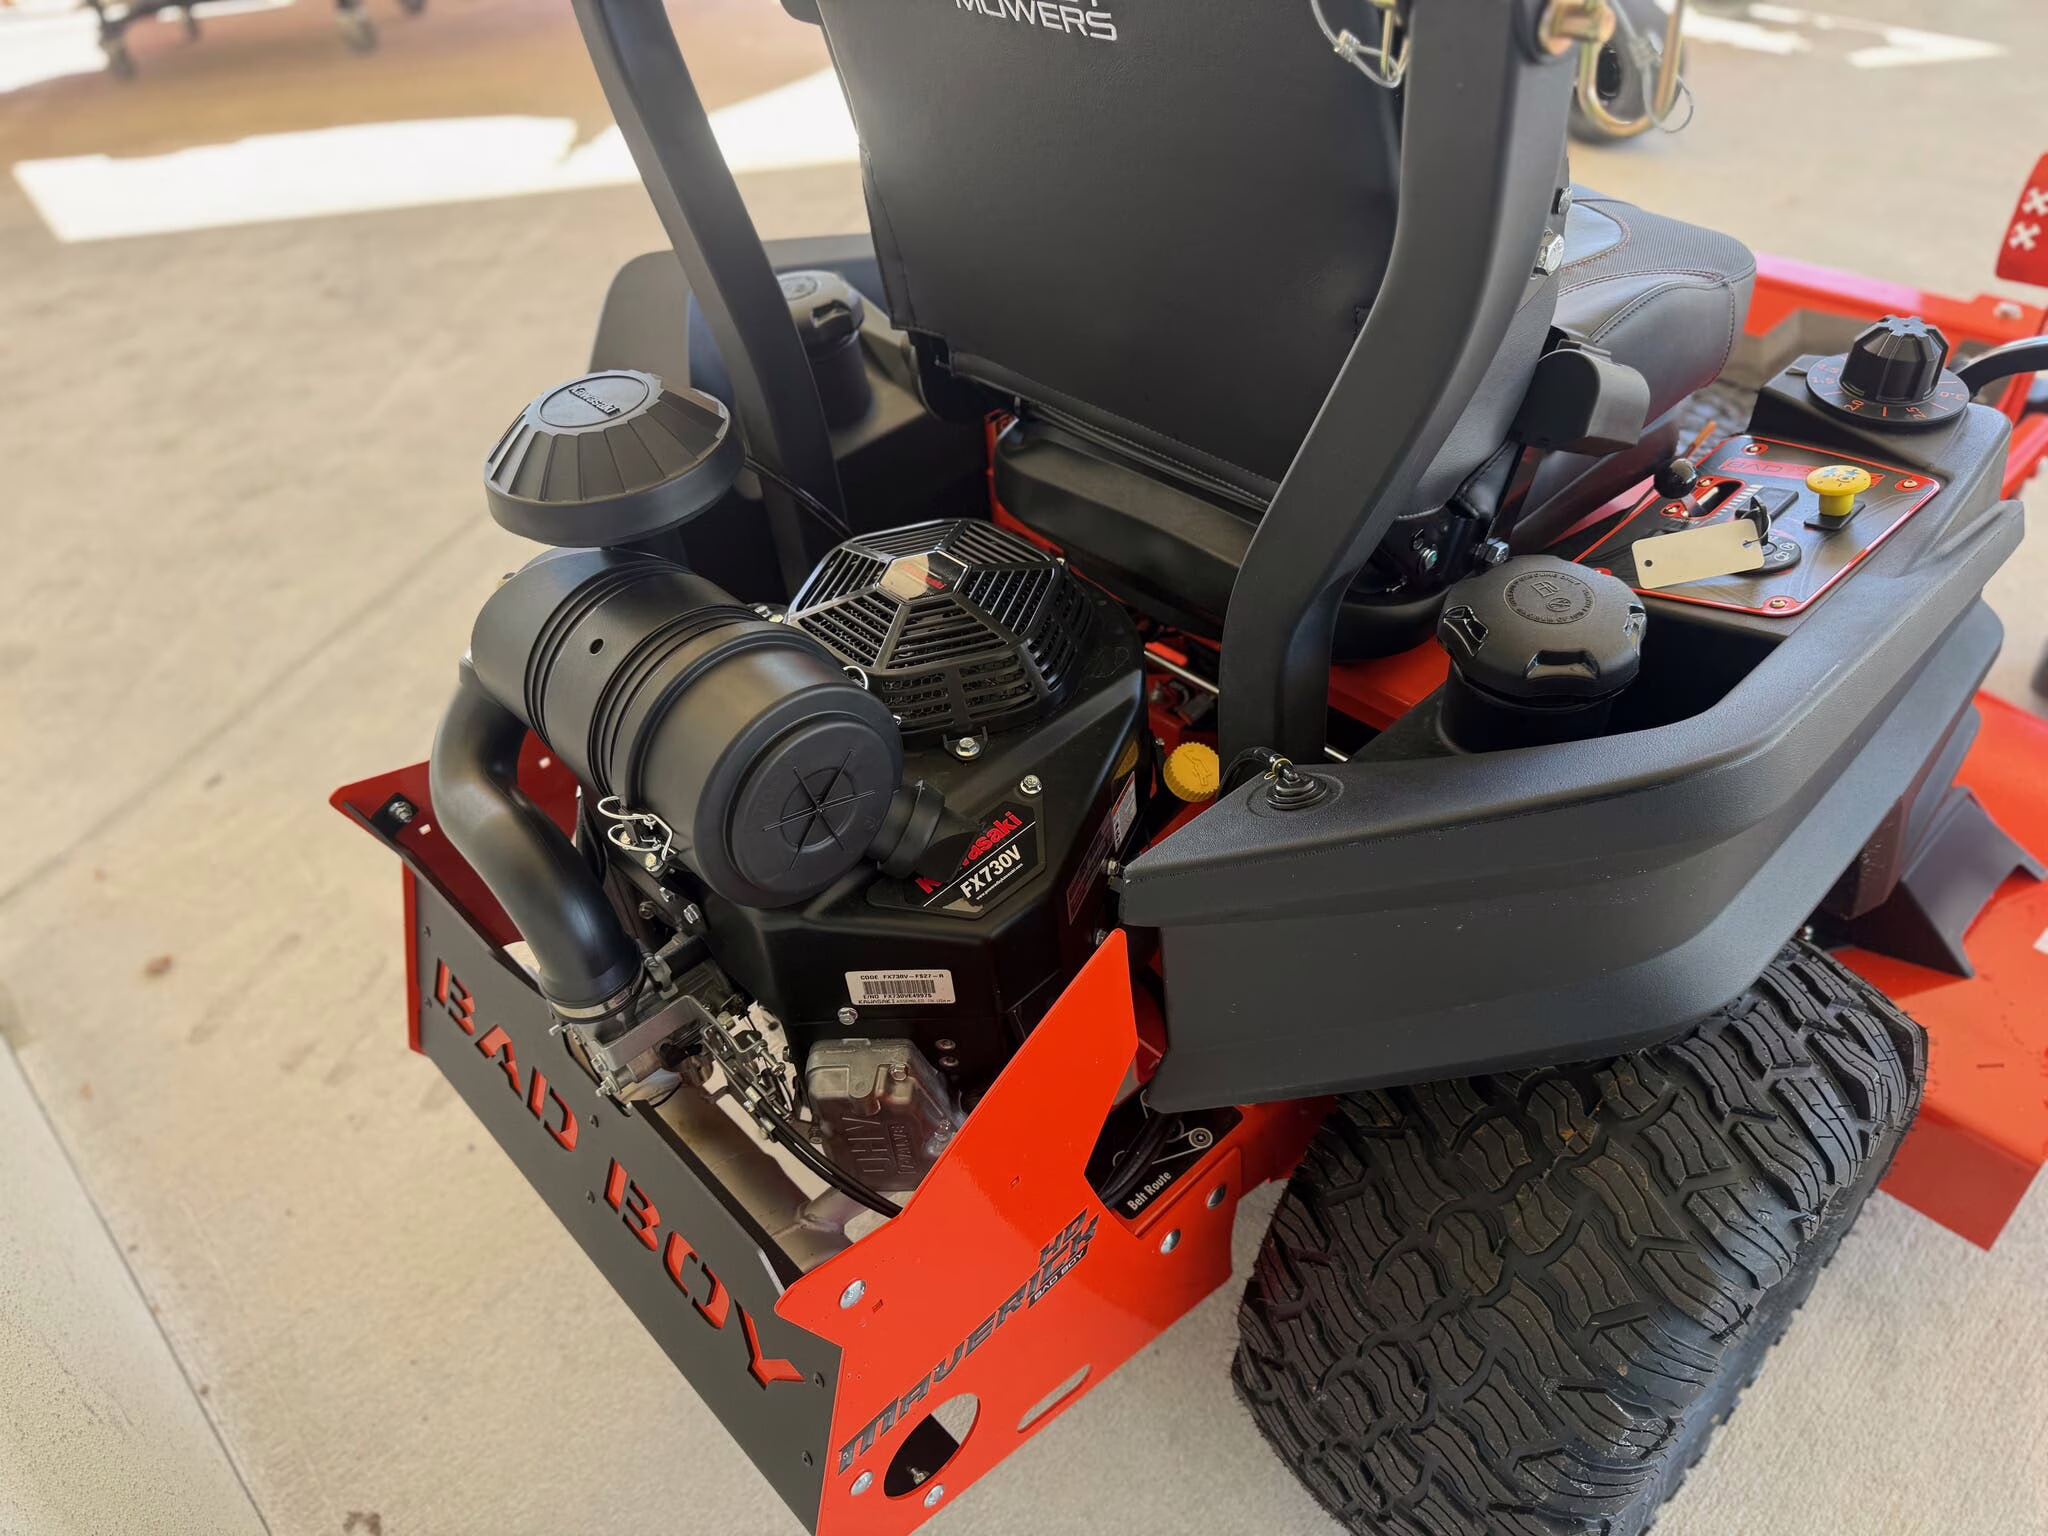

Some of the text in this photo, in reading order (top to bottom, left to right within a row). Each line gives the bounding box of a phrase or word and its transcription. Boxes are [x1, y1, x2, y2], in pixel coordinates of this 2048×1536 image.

[960, 844, 1022, 899] FX730V
[435, 958, 804, 1390] BAD BOY
[1126, 1171, 1172, 1211] Belt Route
[1034, 1249, 1084, 1301] BAD BOY
[838, 1213, 1100, 1476] MAVERICK
